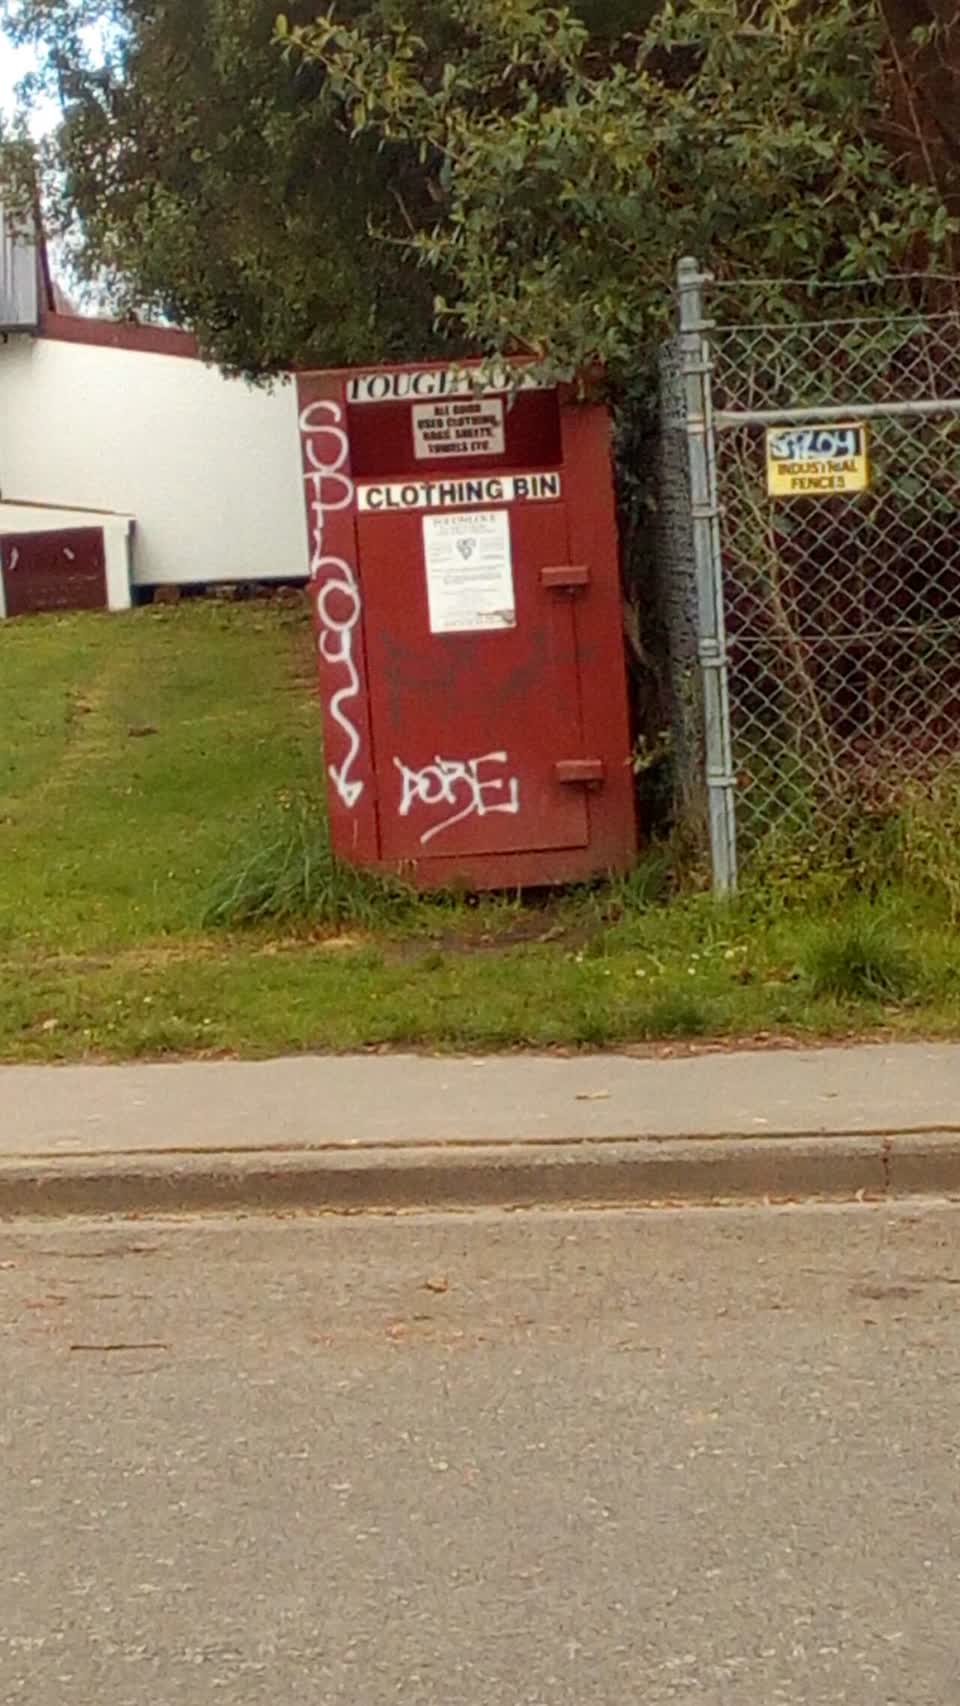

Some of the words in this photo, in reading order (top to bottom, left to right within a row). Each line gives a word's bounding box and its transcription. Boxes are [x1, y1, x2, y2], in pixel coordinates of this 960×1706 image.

[417, 418, 443, 429] USED
[777, 459, 857, 475] INDUSTRIAL
[790, 475, 845, 489] FENCES
[366, 479, 504, 508] CLOTHING
[512, 475, 558, 498] BIN
